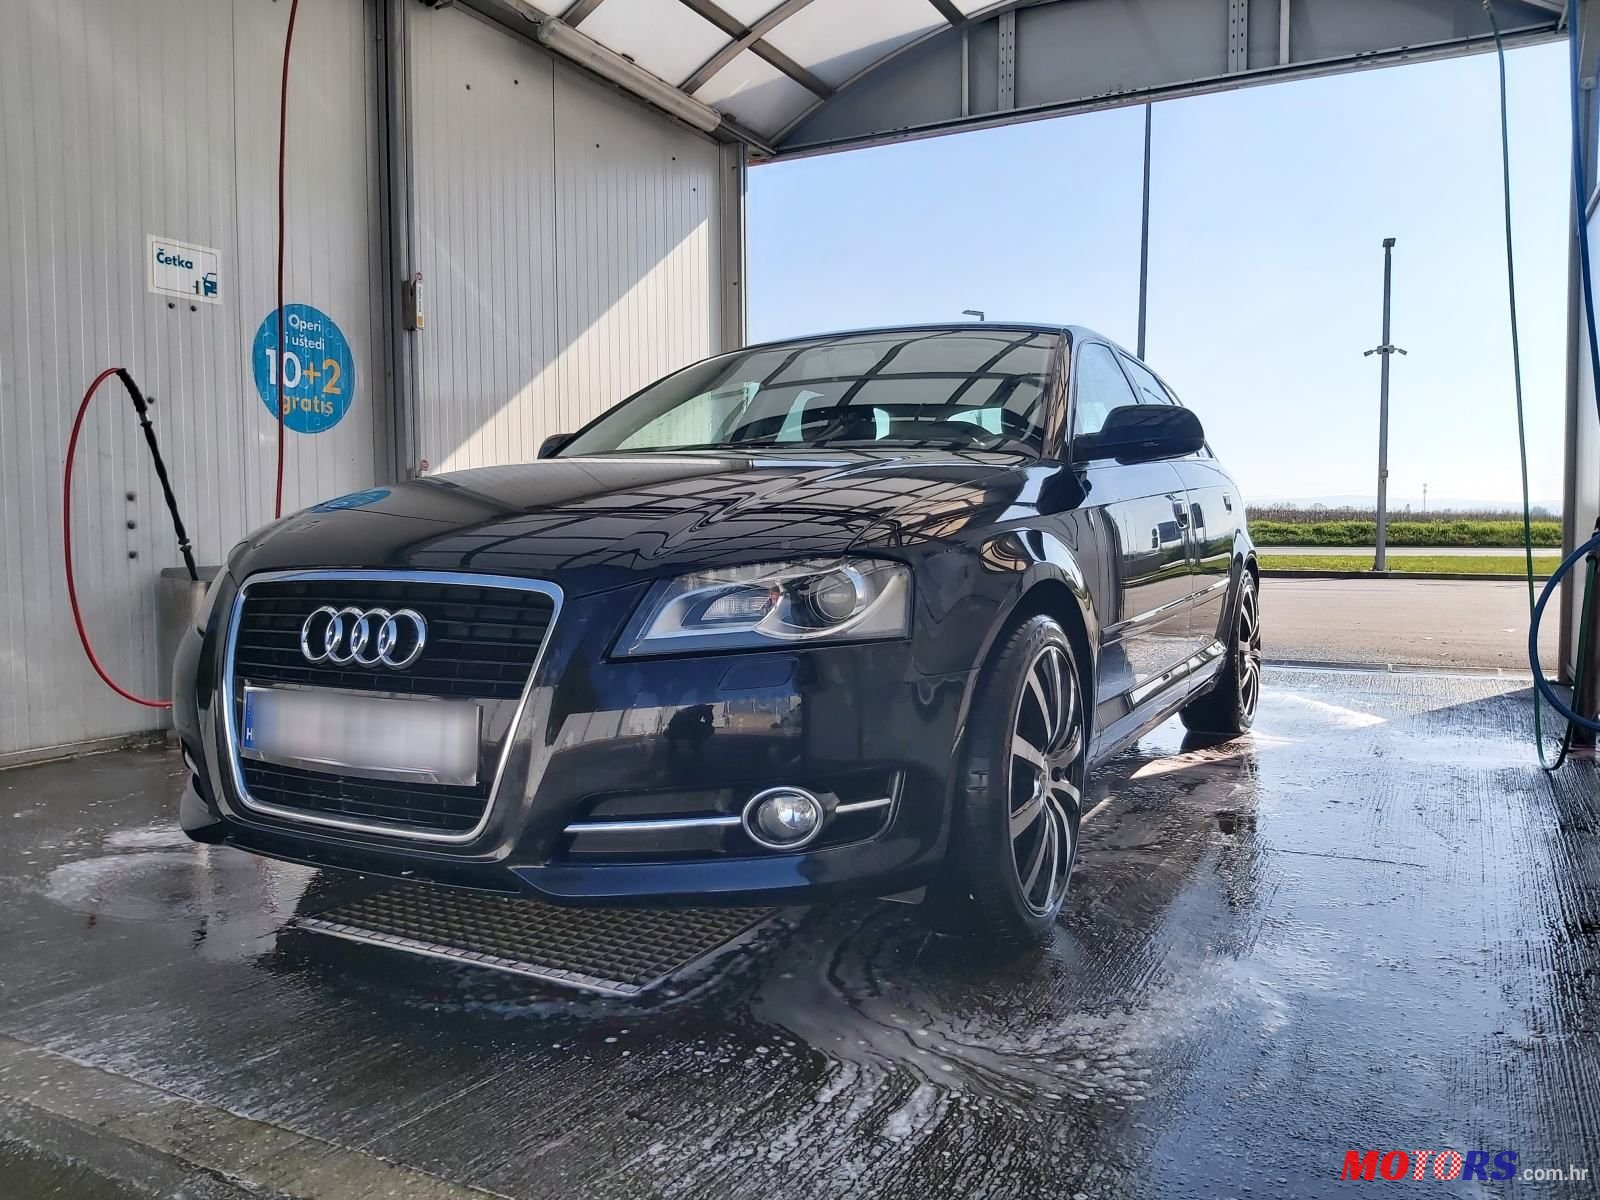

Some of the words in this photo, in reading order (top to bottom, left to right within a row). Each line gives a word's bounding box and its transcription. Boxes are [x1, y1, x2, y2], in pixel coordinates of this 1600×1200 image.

[156, 248, 194, 270] Četka
[287, 314, 321, 333] Operi
[285, 332, 289, 344] i
[291, 334, 325, 351] uštedi
[265, 348, 342, 395] 10+2
[282, 395, 334, 415] gratis
